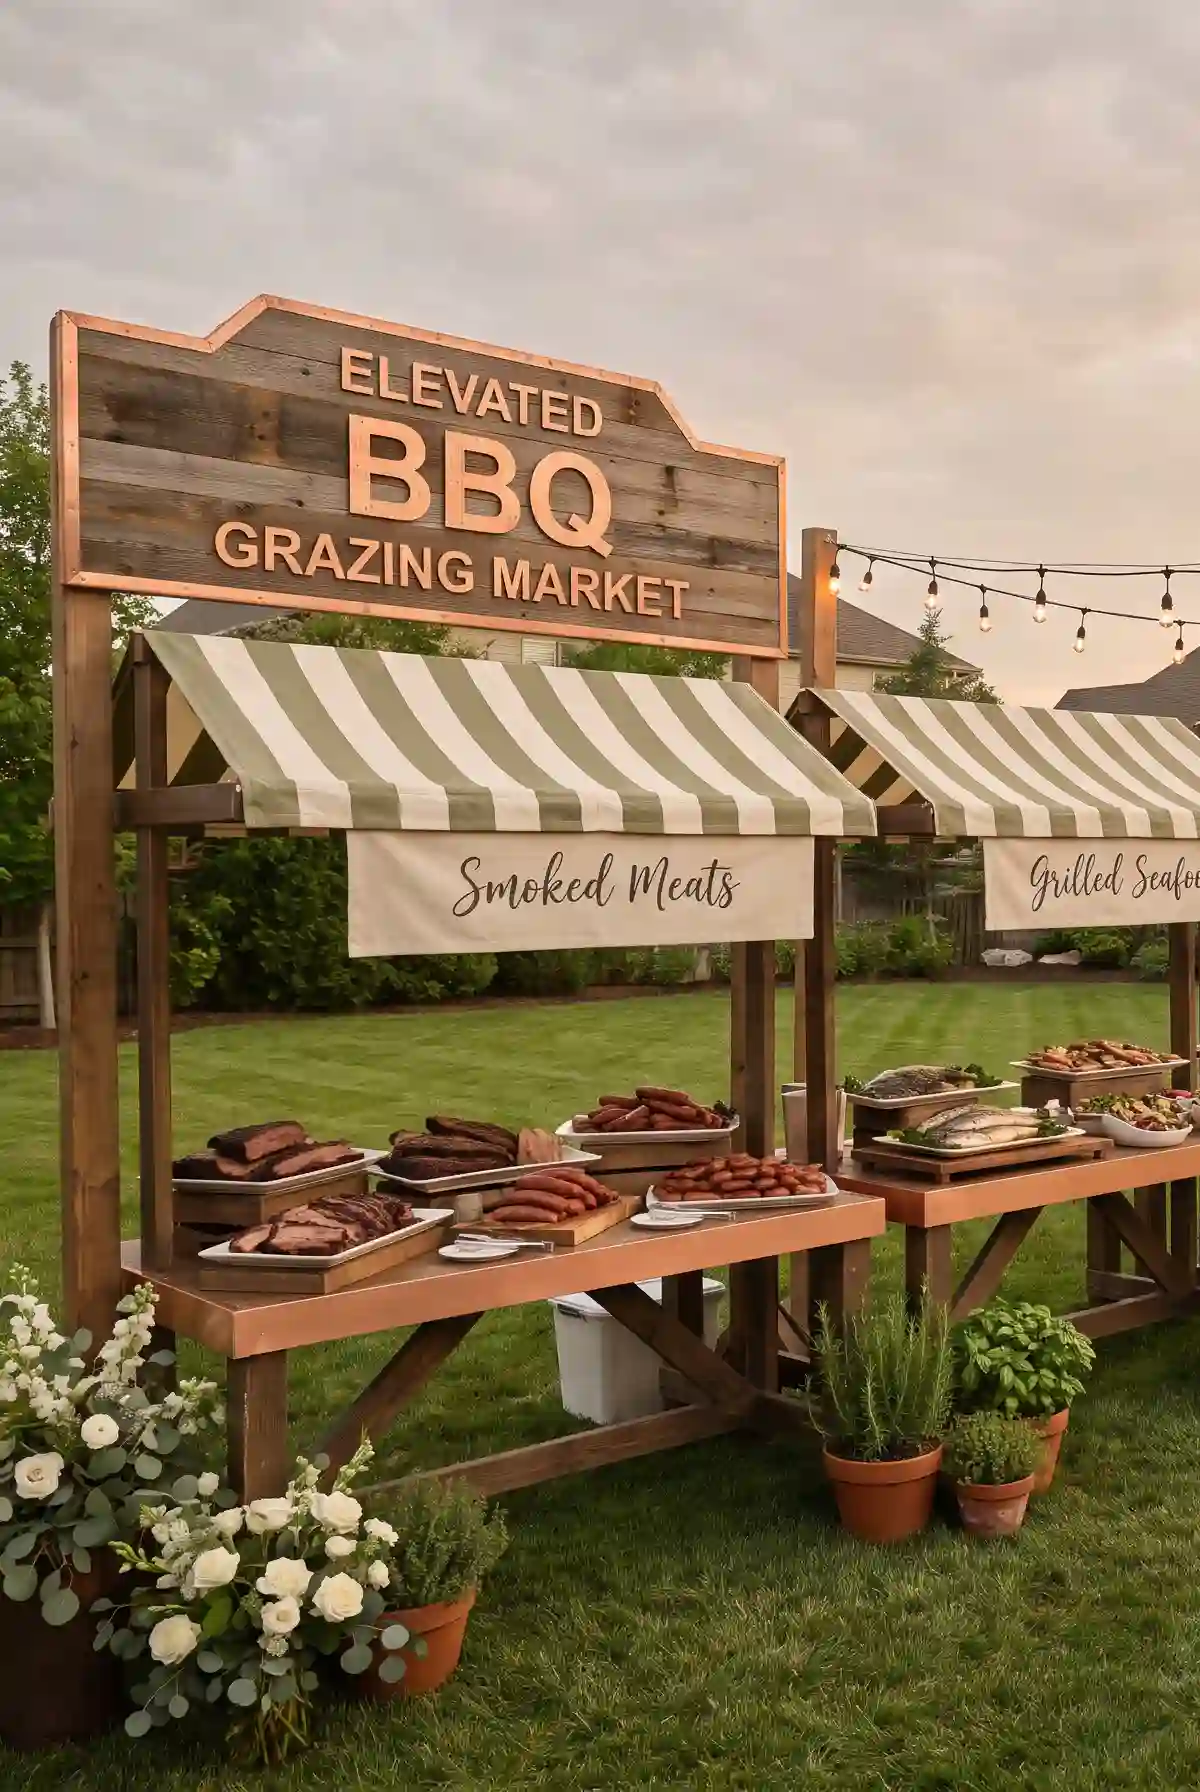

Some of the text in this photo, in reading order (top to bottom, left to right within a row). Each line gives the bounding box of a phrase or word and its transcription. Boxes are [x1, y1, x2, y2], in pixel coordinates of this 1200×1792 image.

[340, 347, 603, 437] ELEVATED
[347, 414, 613, 557] BBQ
[214, 521, 690, 620] GRAZING MARKET
[453, 851, 741, 917] Smoked Meats
[1030, 853, 1124, 911] Grilled
